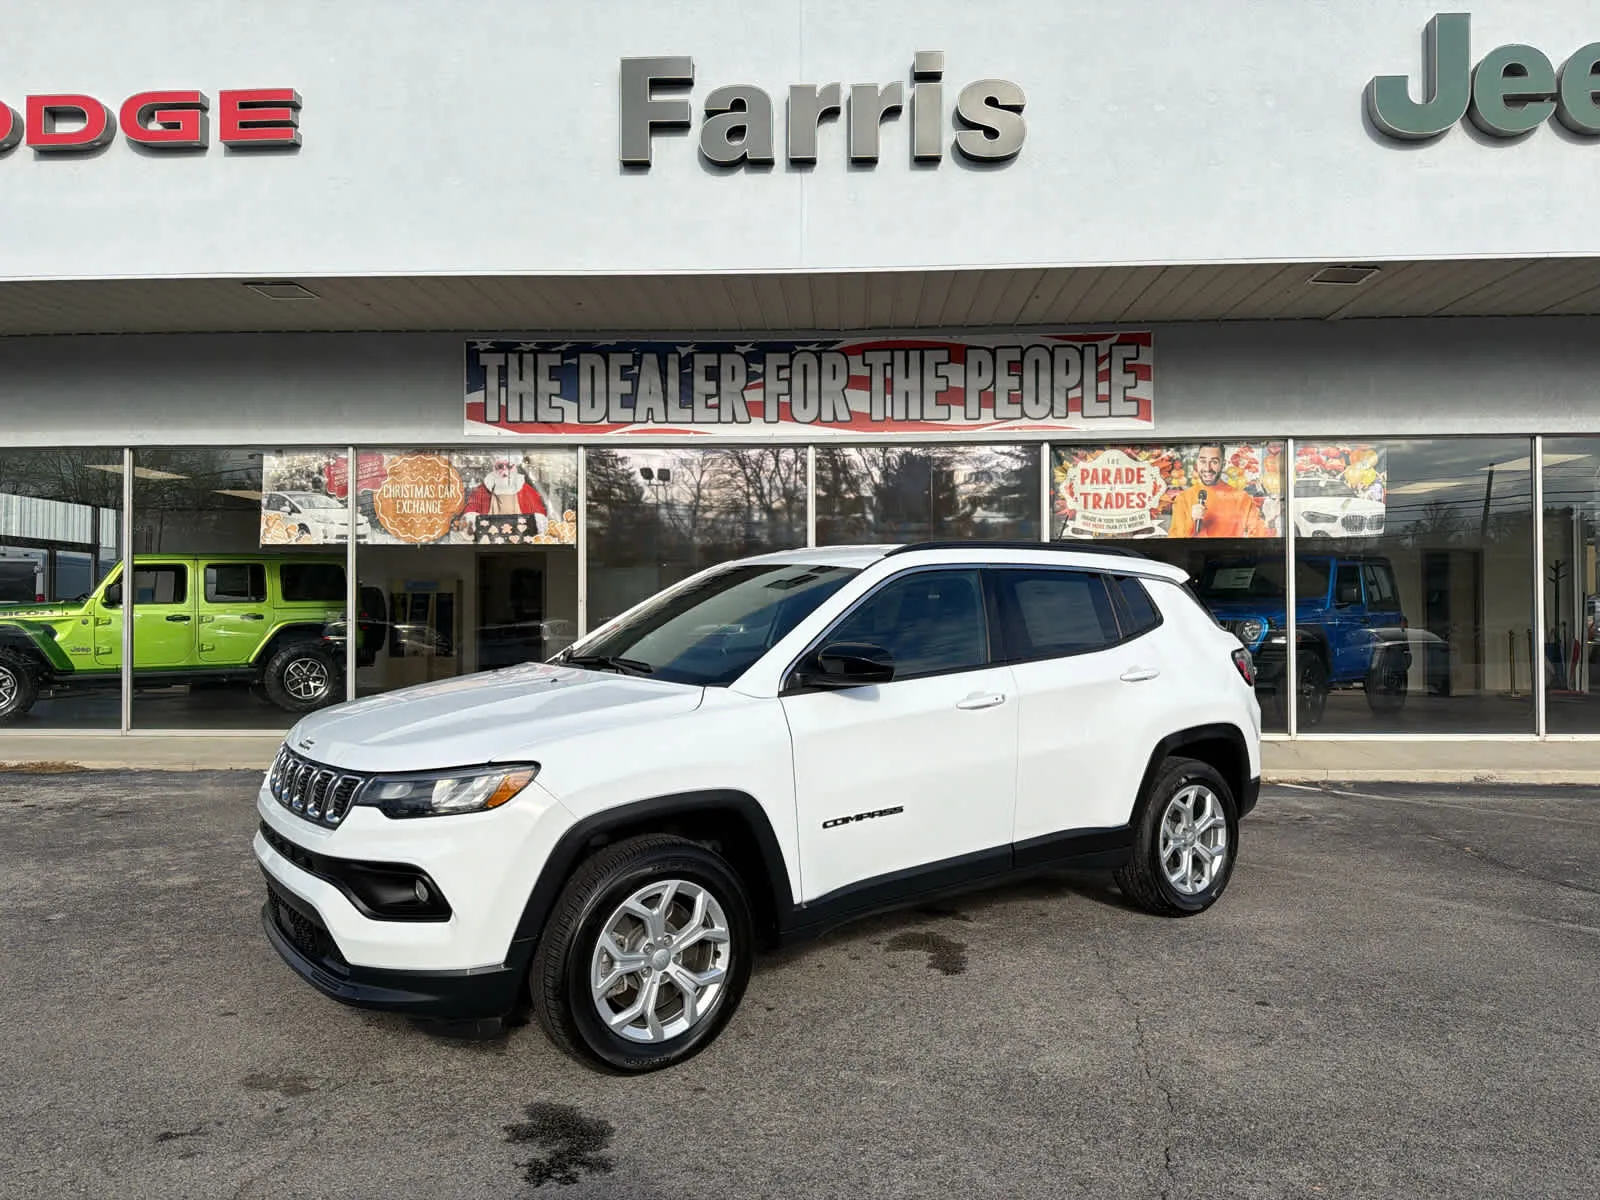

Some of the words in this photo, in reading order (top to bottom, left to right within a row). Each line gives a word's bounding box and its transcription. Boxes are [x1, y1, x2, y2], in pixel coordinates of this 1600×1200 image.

[0, 88, 302, 151] DGE
[617, 50, 1027, 168] Farris
[476, 350, 566, 424] THE
[576, 350, 752, 425] DEALER
[762, 348, 853, 424] FOR
[862, 347, 951, 422] THE
[963, 342, 1140, 420] PEOPLE
[1079, 467, 1147, 485] PARADE
[383, 484, 435, 499] CHRISTMAS
[438, 484, 457, 499] CAR
[1079, 492, 1147, 510] TRADES
[396, 499, 444, 514] EXCHANGE
[822, 805, 905, 829] COMPASS
